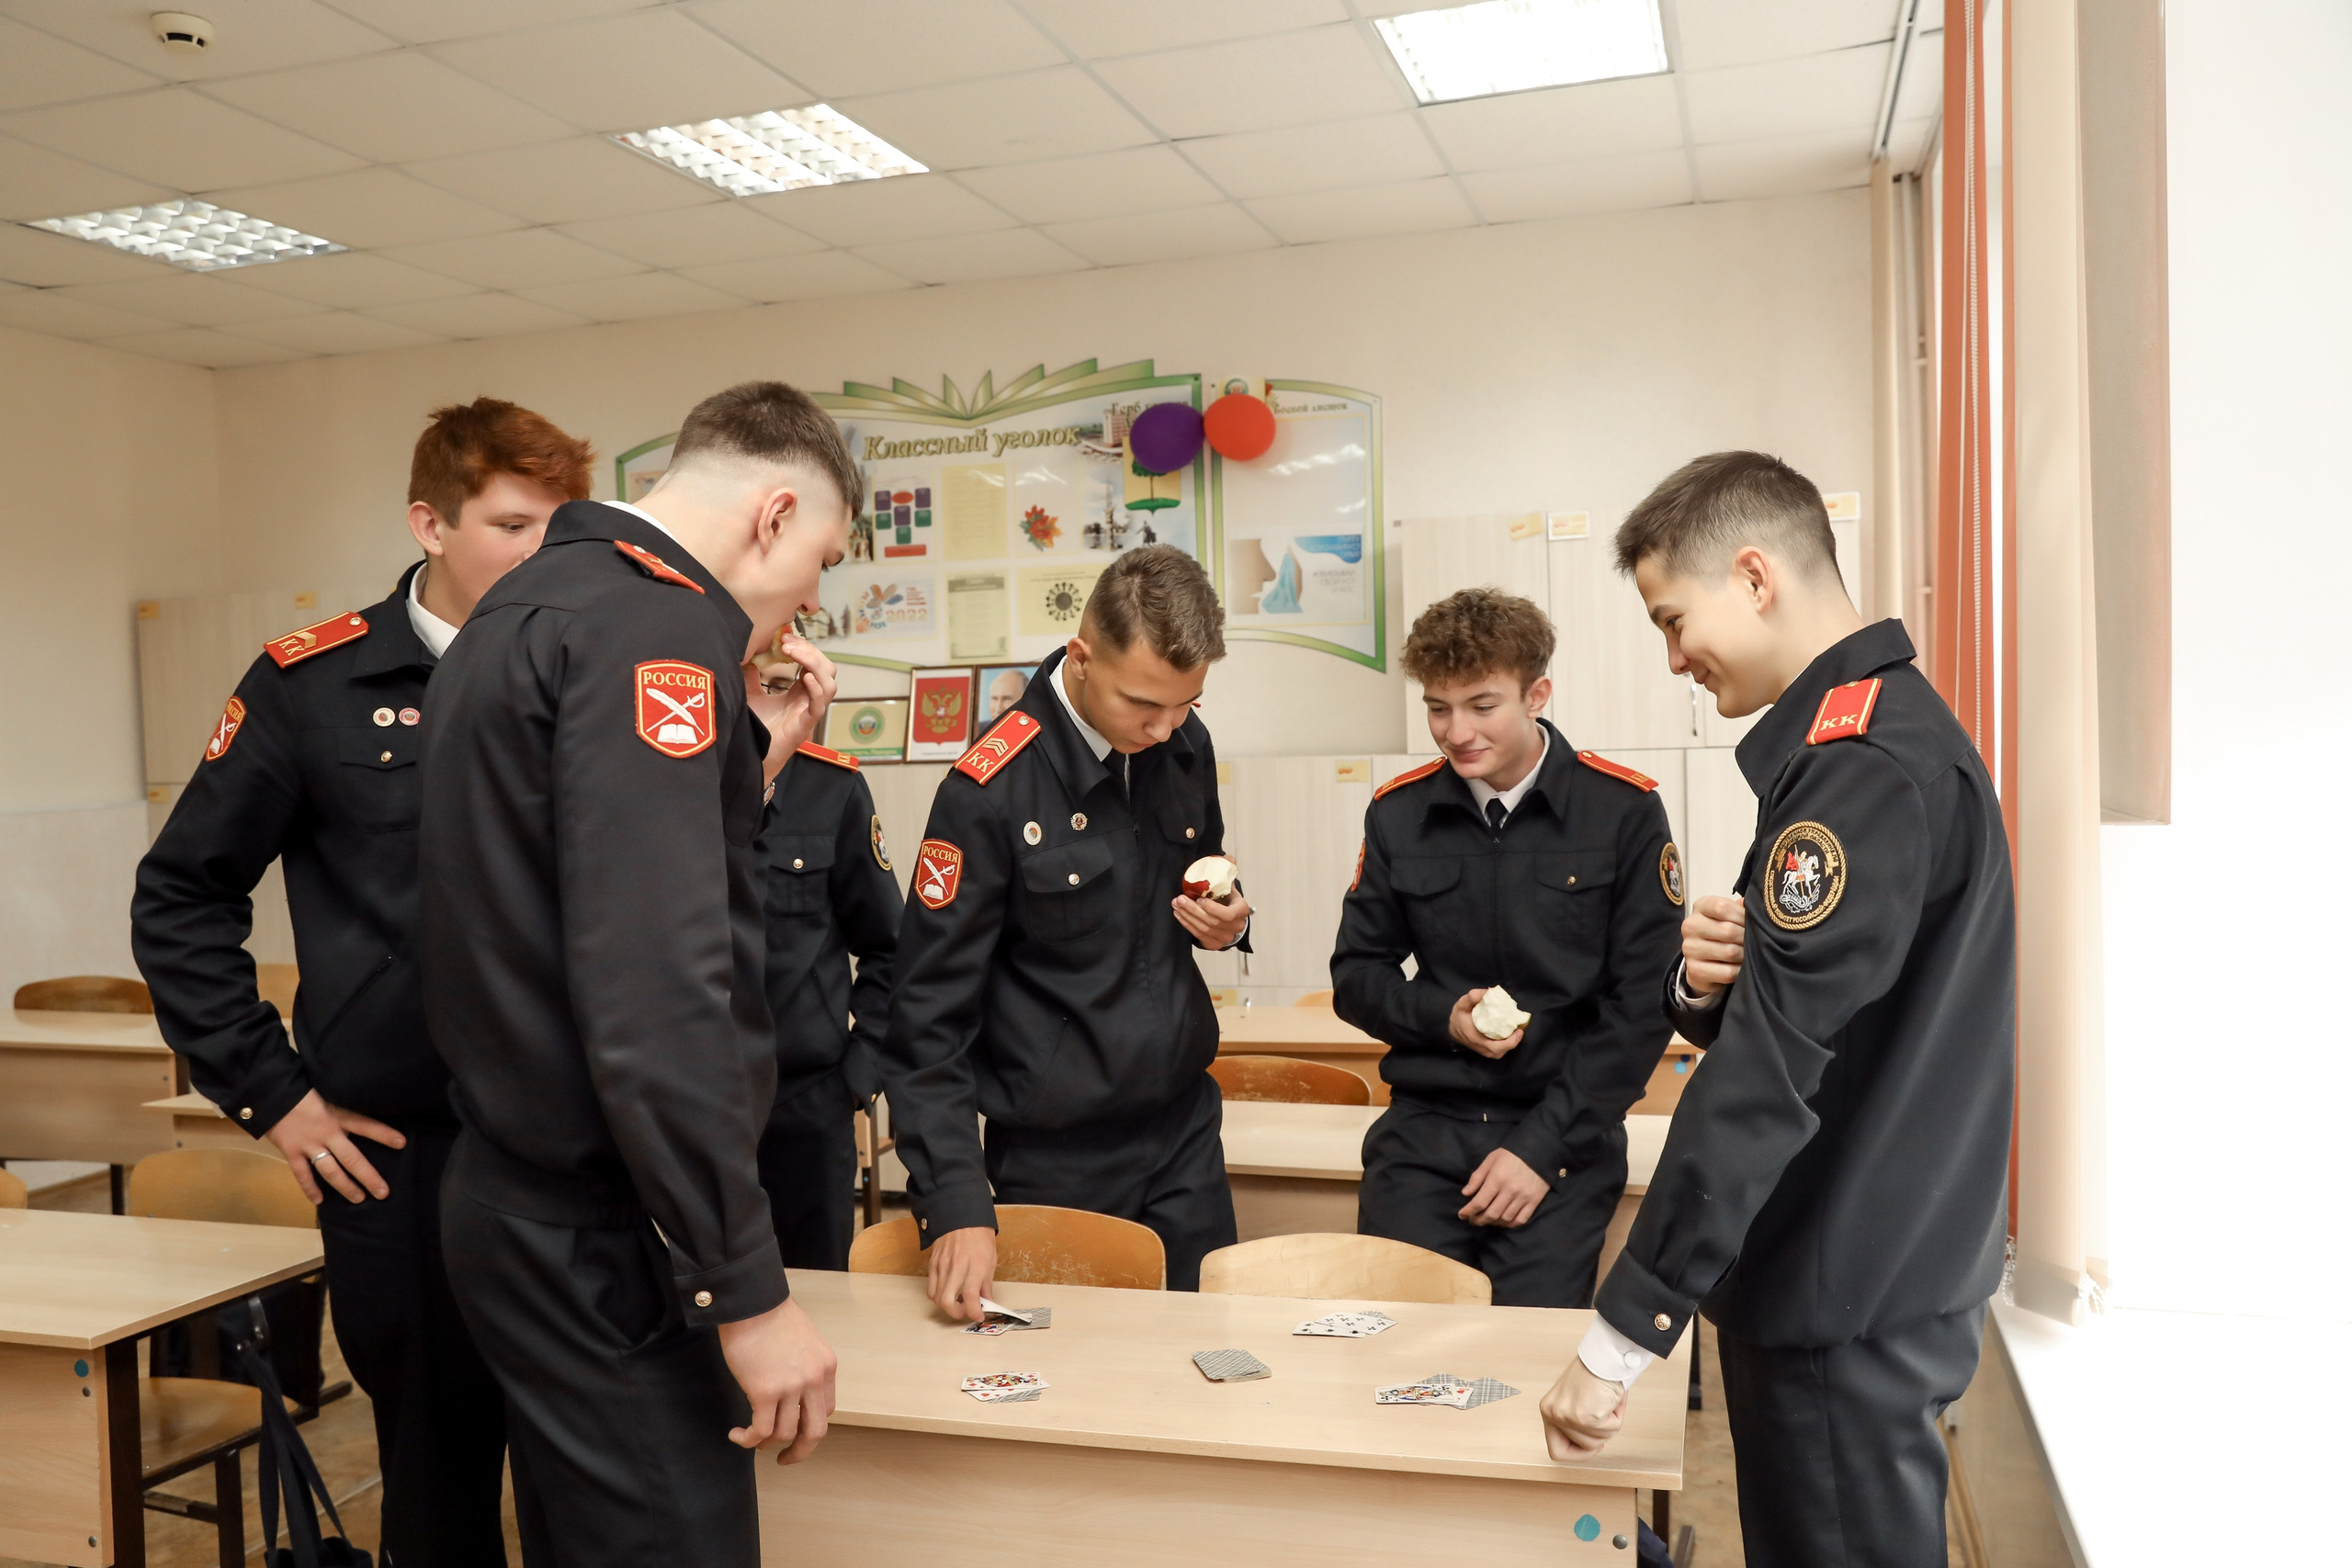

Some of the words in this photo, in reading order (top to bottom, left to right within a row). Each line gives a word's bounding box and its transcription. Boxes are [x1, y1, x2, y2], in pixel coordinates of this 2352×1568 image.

[863, 428, 988, 460] Классный
[993, 426, 1081, 457] уголок
[886, 608, 928, 623] 2022
[278, 637, 305, 657] КК
[643, 671, 707, 690] РОССИЯ
[226, 702, 243, 721] ССИЯ
[1819, 714, 1858, 731] КК
[967, 751, 995, 773] КК
[922, 845, 959, 863] РОССИЯ
